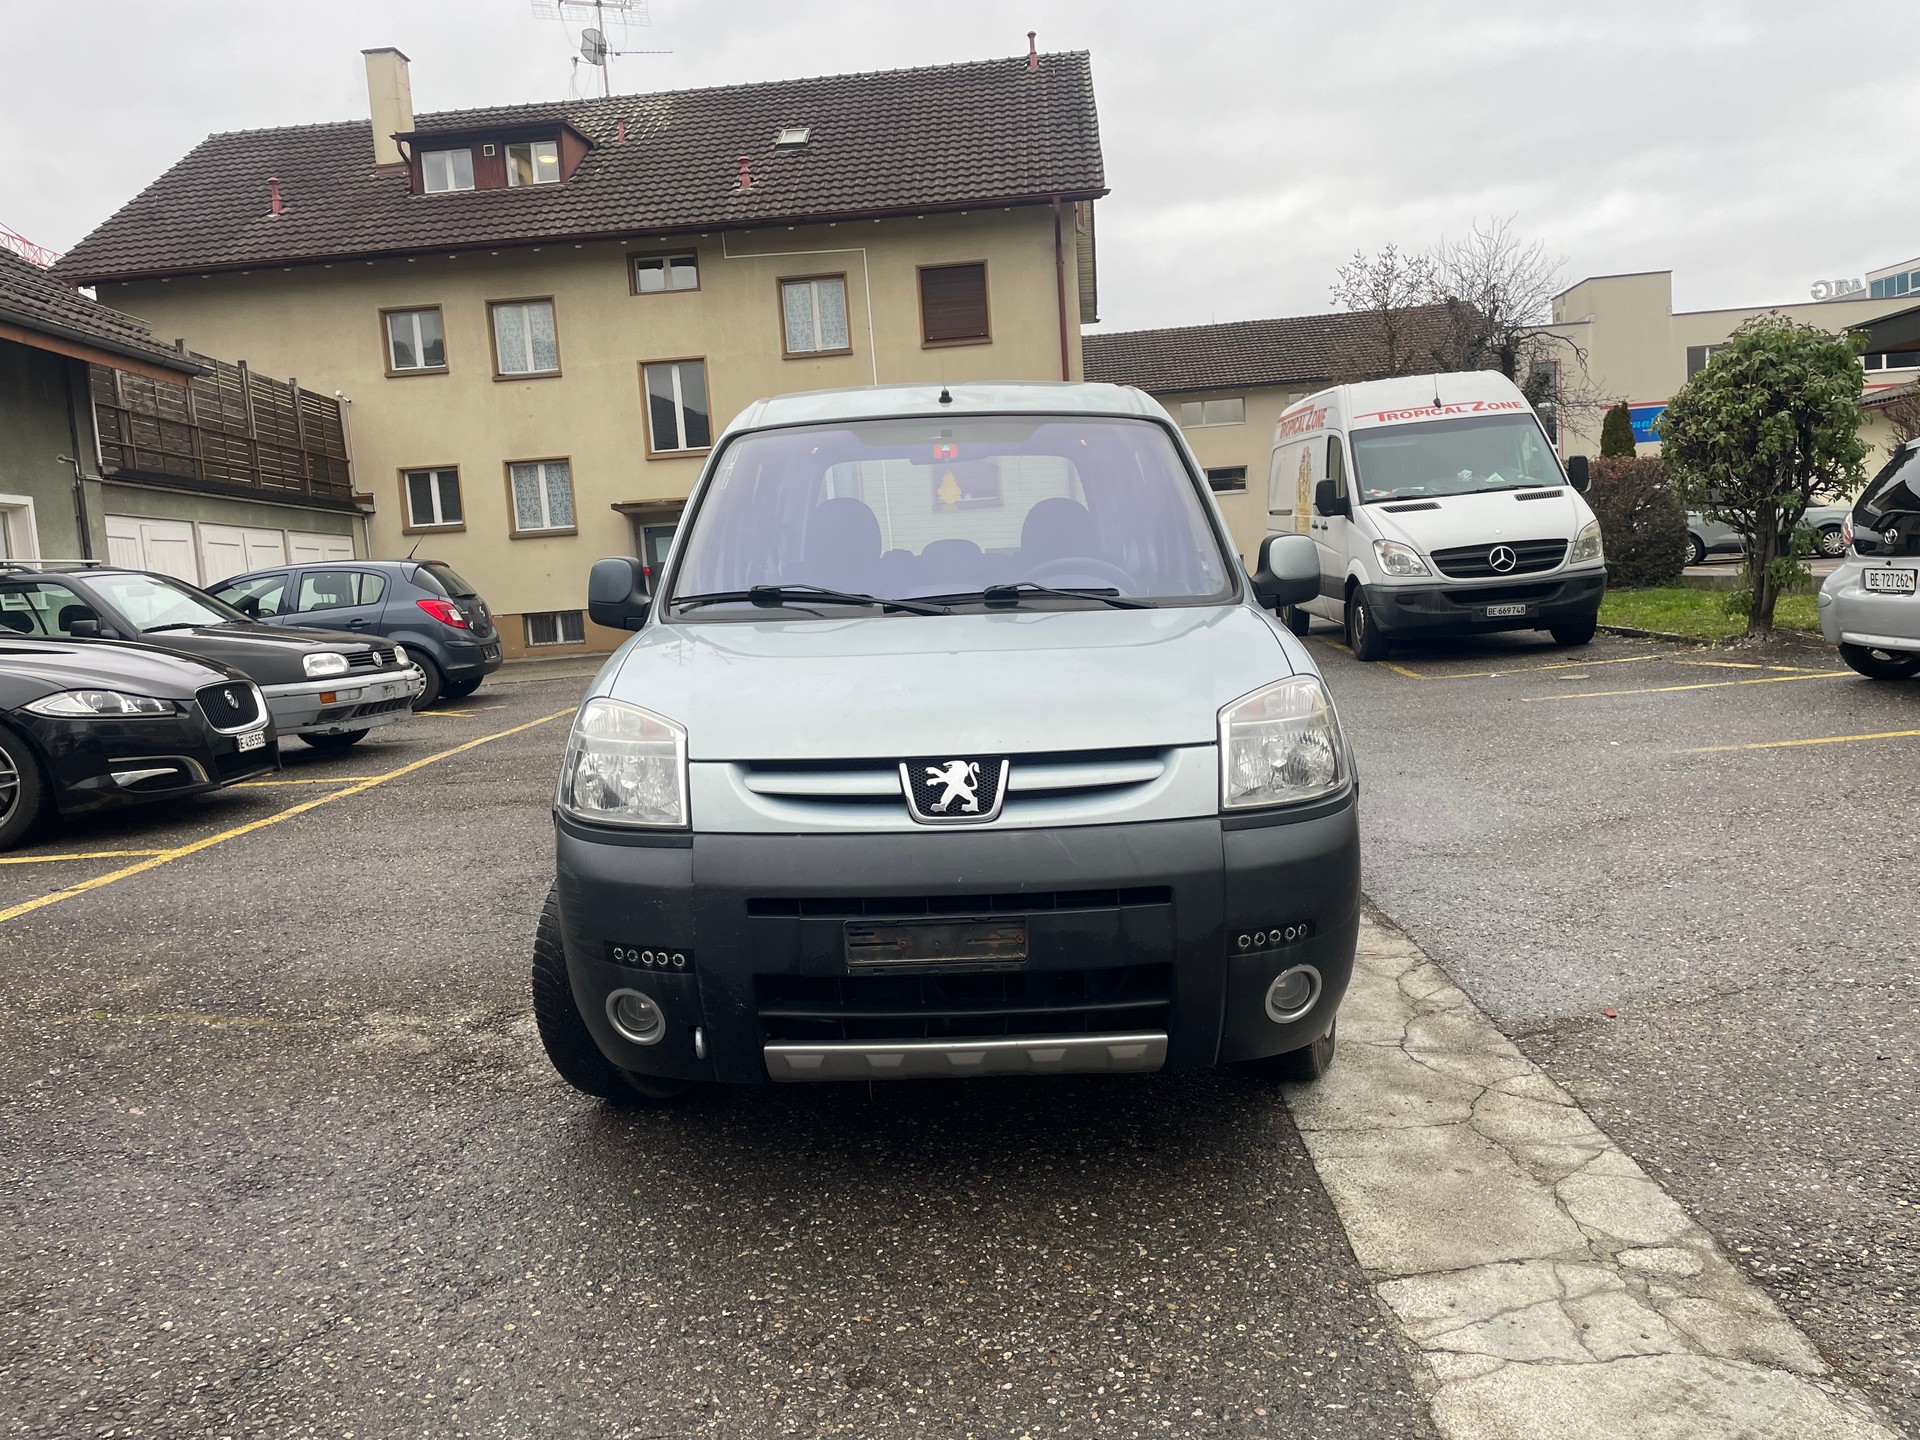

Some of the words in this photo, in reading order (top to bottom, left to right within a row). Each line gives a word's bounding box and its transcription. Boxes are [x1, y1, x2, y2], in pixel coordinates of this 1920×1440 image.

[1305, 406, 1327, 431] ZONE
[1374, 406, 1468, 422] TROPICAL
[1471, 400, 1525, 412] ZONE
